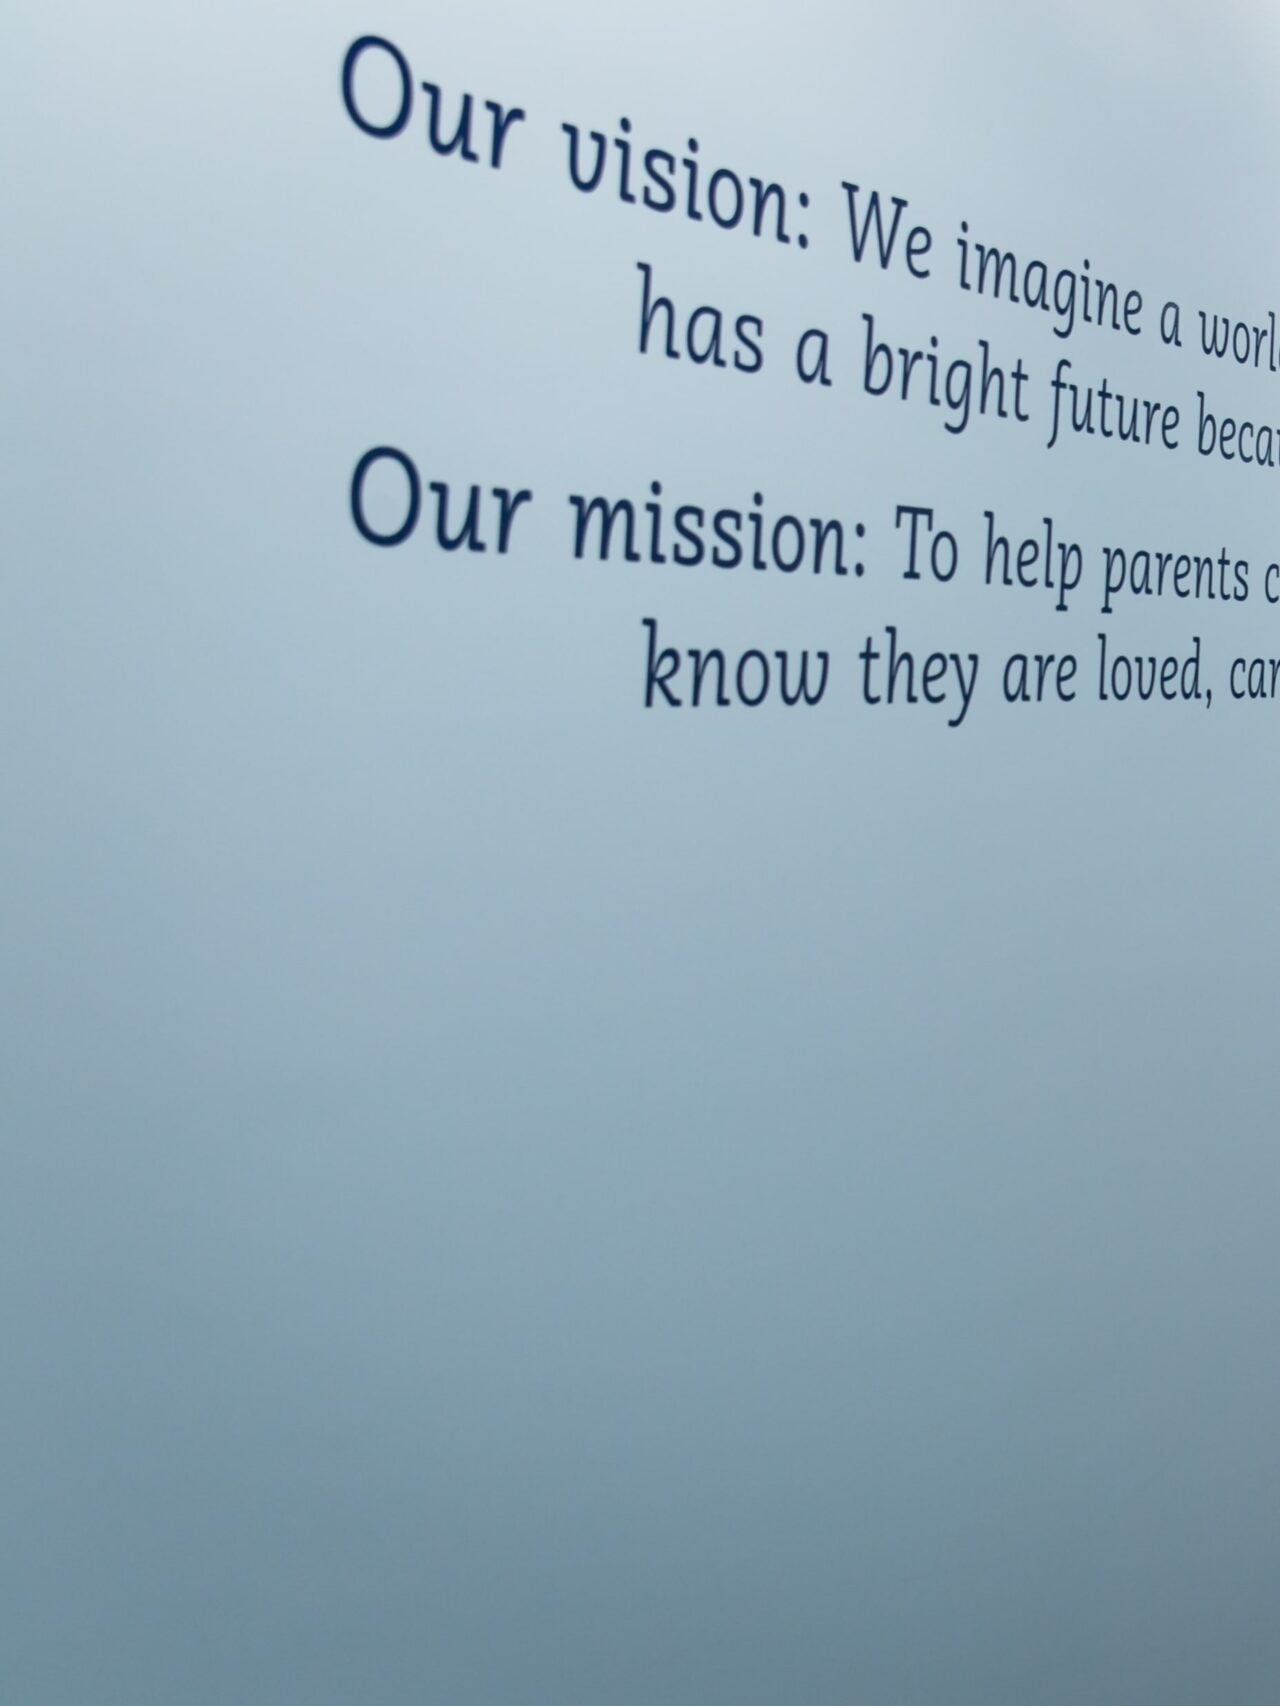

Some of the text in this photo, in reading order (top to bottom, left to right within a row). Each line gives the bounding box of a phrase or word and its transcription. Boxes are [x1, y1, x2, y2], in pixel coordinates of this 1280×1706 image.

[339, 33, 527, 170] Our
[560, 116, 810, 250] vision:
[841, 180, 932, 279] We
[956, 220, 1143, 339] imagine
[1160, 301, 1182, 347] a
[636, 261, 764, 374] has
[795, 328, 832, 387] a
[861, 312, 1029, 435] bright
[1046, 358, 1180, 450] future
[348, 444, 533, 555] Our
[568, 480, 866, 578] mission:
[895, 504, 958, 583] To
[983, 510, 1083, 612] help
[1101, 547, 1249, 614] parents
[641, 617, 830, 709] know
[858, 625, 979, 728] they
[1003, 653, 1077, 703] are
[1097, 633, 1212, 709] loved,
